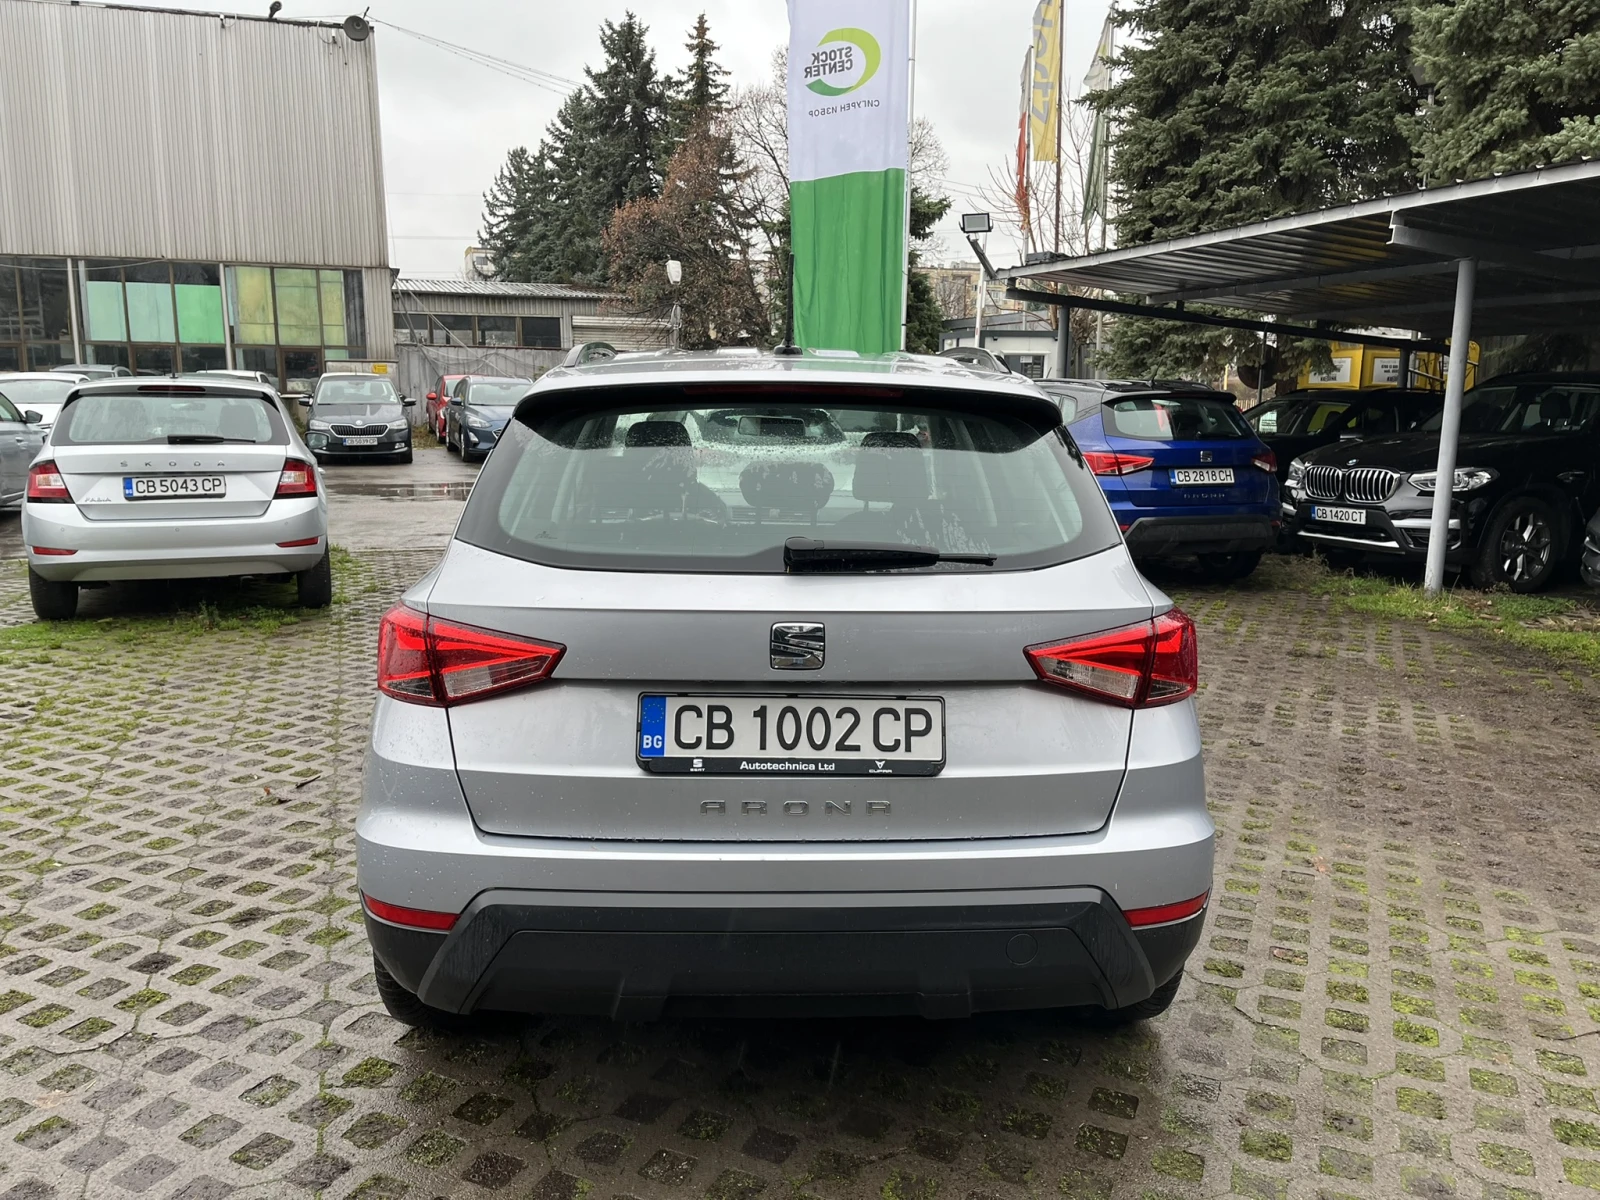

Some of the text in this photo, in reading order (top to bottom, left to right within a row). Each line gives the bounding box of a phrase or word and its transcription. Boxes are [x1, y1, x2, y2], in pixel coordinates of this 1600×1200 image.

[1177, 470, 1191, 482] CB
[1192, 470, 1218, 482] 2818
[1218, 469, 1233, 482] CH
[135, 477, 222, 494] CB 5043 CP
[1316, 507, 1328, 519] CB
[1329, 509, 1350, 521] 1420
[1351, 510, 1364, 522] CT
[674, 704, 933, 753] CB 1002 CP
[642, 735, 663, 749] BG
[739, 761, 836, 771] Autotechnica Ltd
[701, 799, 892, 816] ARONA
